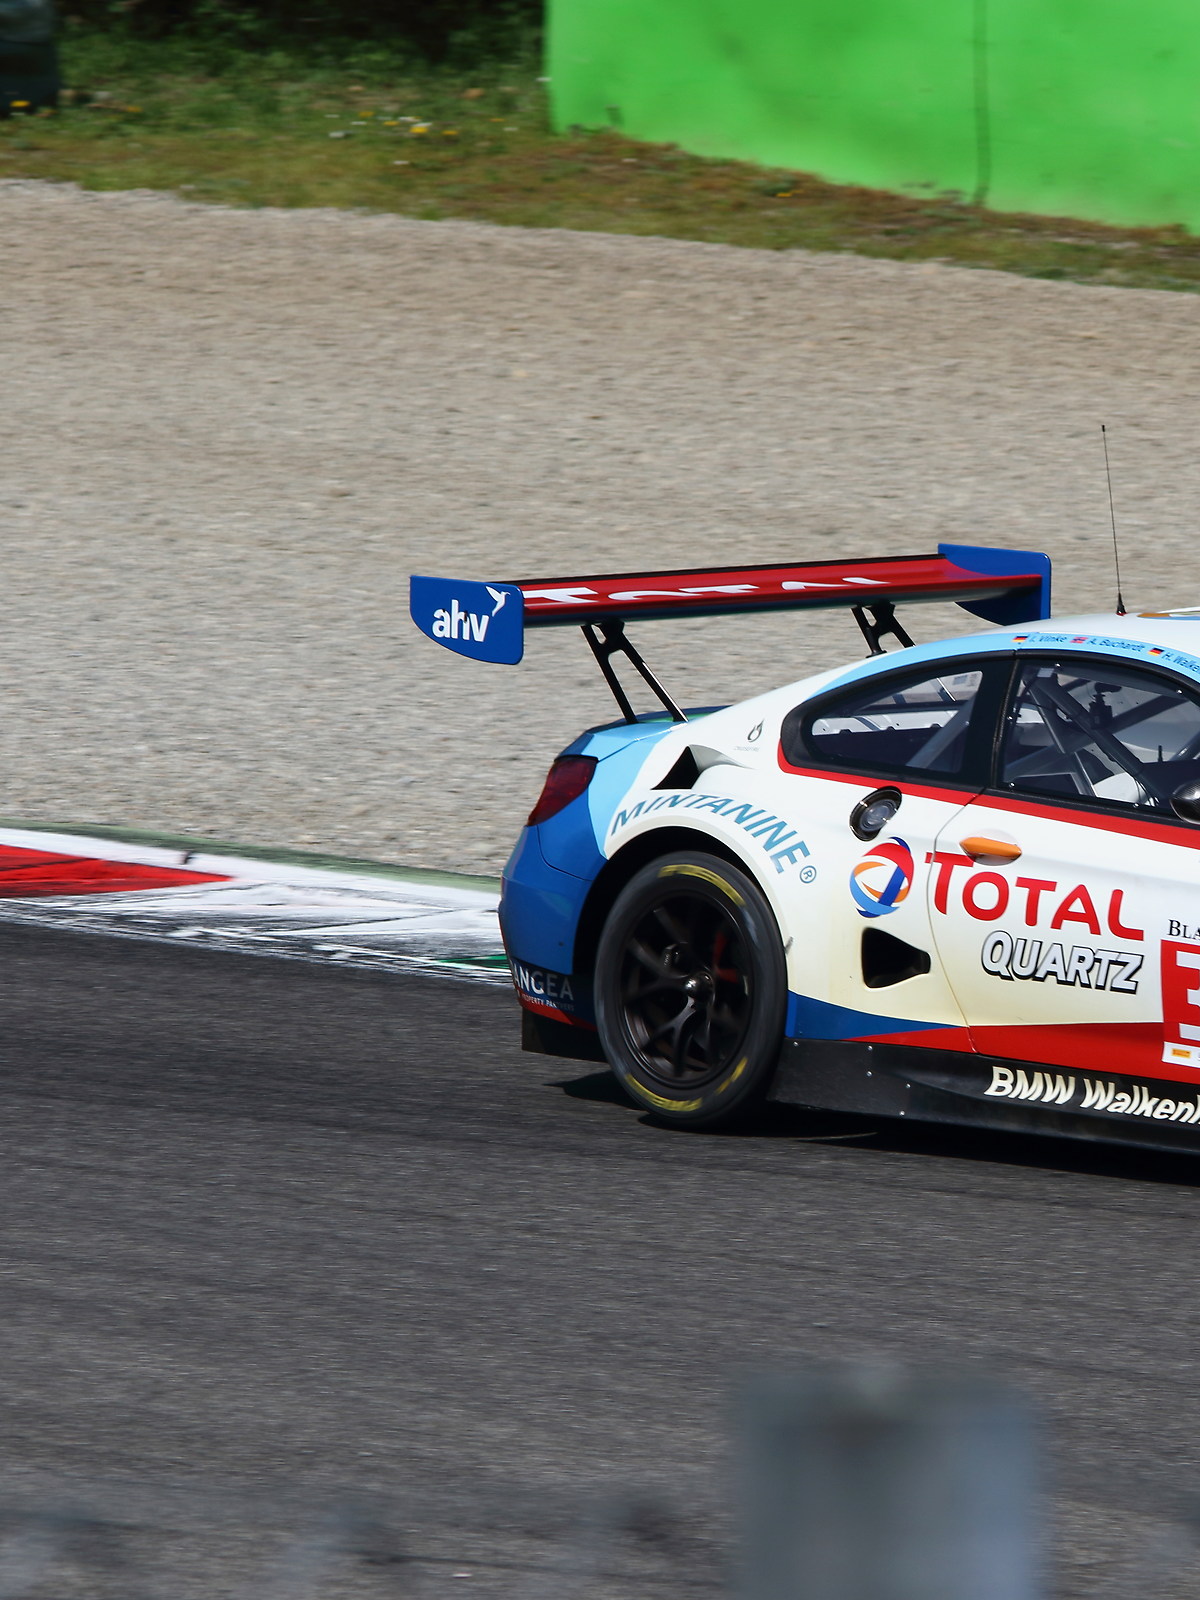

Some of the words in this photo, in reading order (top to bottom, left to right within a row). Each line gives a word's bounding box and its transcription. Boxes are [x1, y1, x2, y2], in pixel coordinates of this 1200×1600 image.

[432, 599, 489, 642] ahv
[925, 851, 1144, 941] TOTAL
[510, 962, 574, 1001] ANGEA
[981, 930, 1145, 994] QUARTZ
[984, 1066, 1076, 1105] BMW
